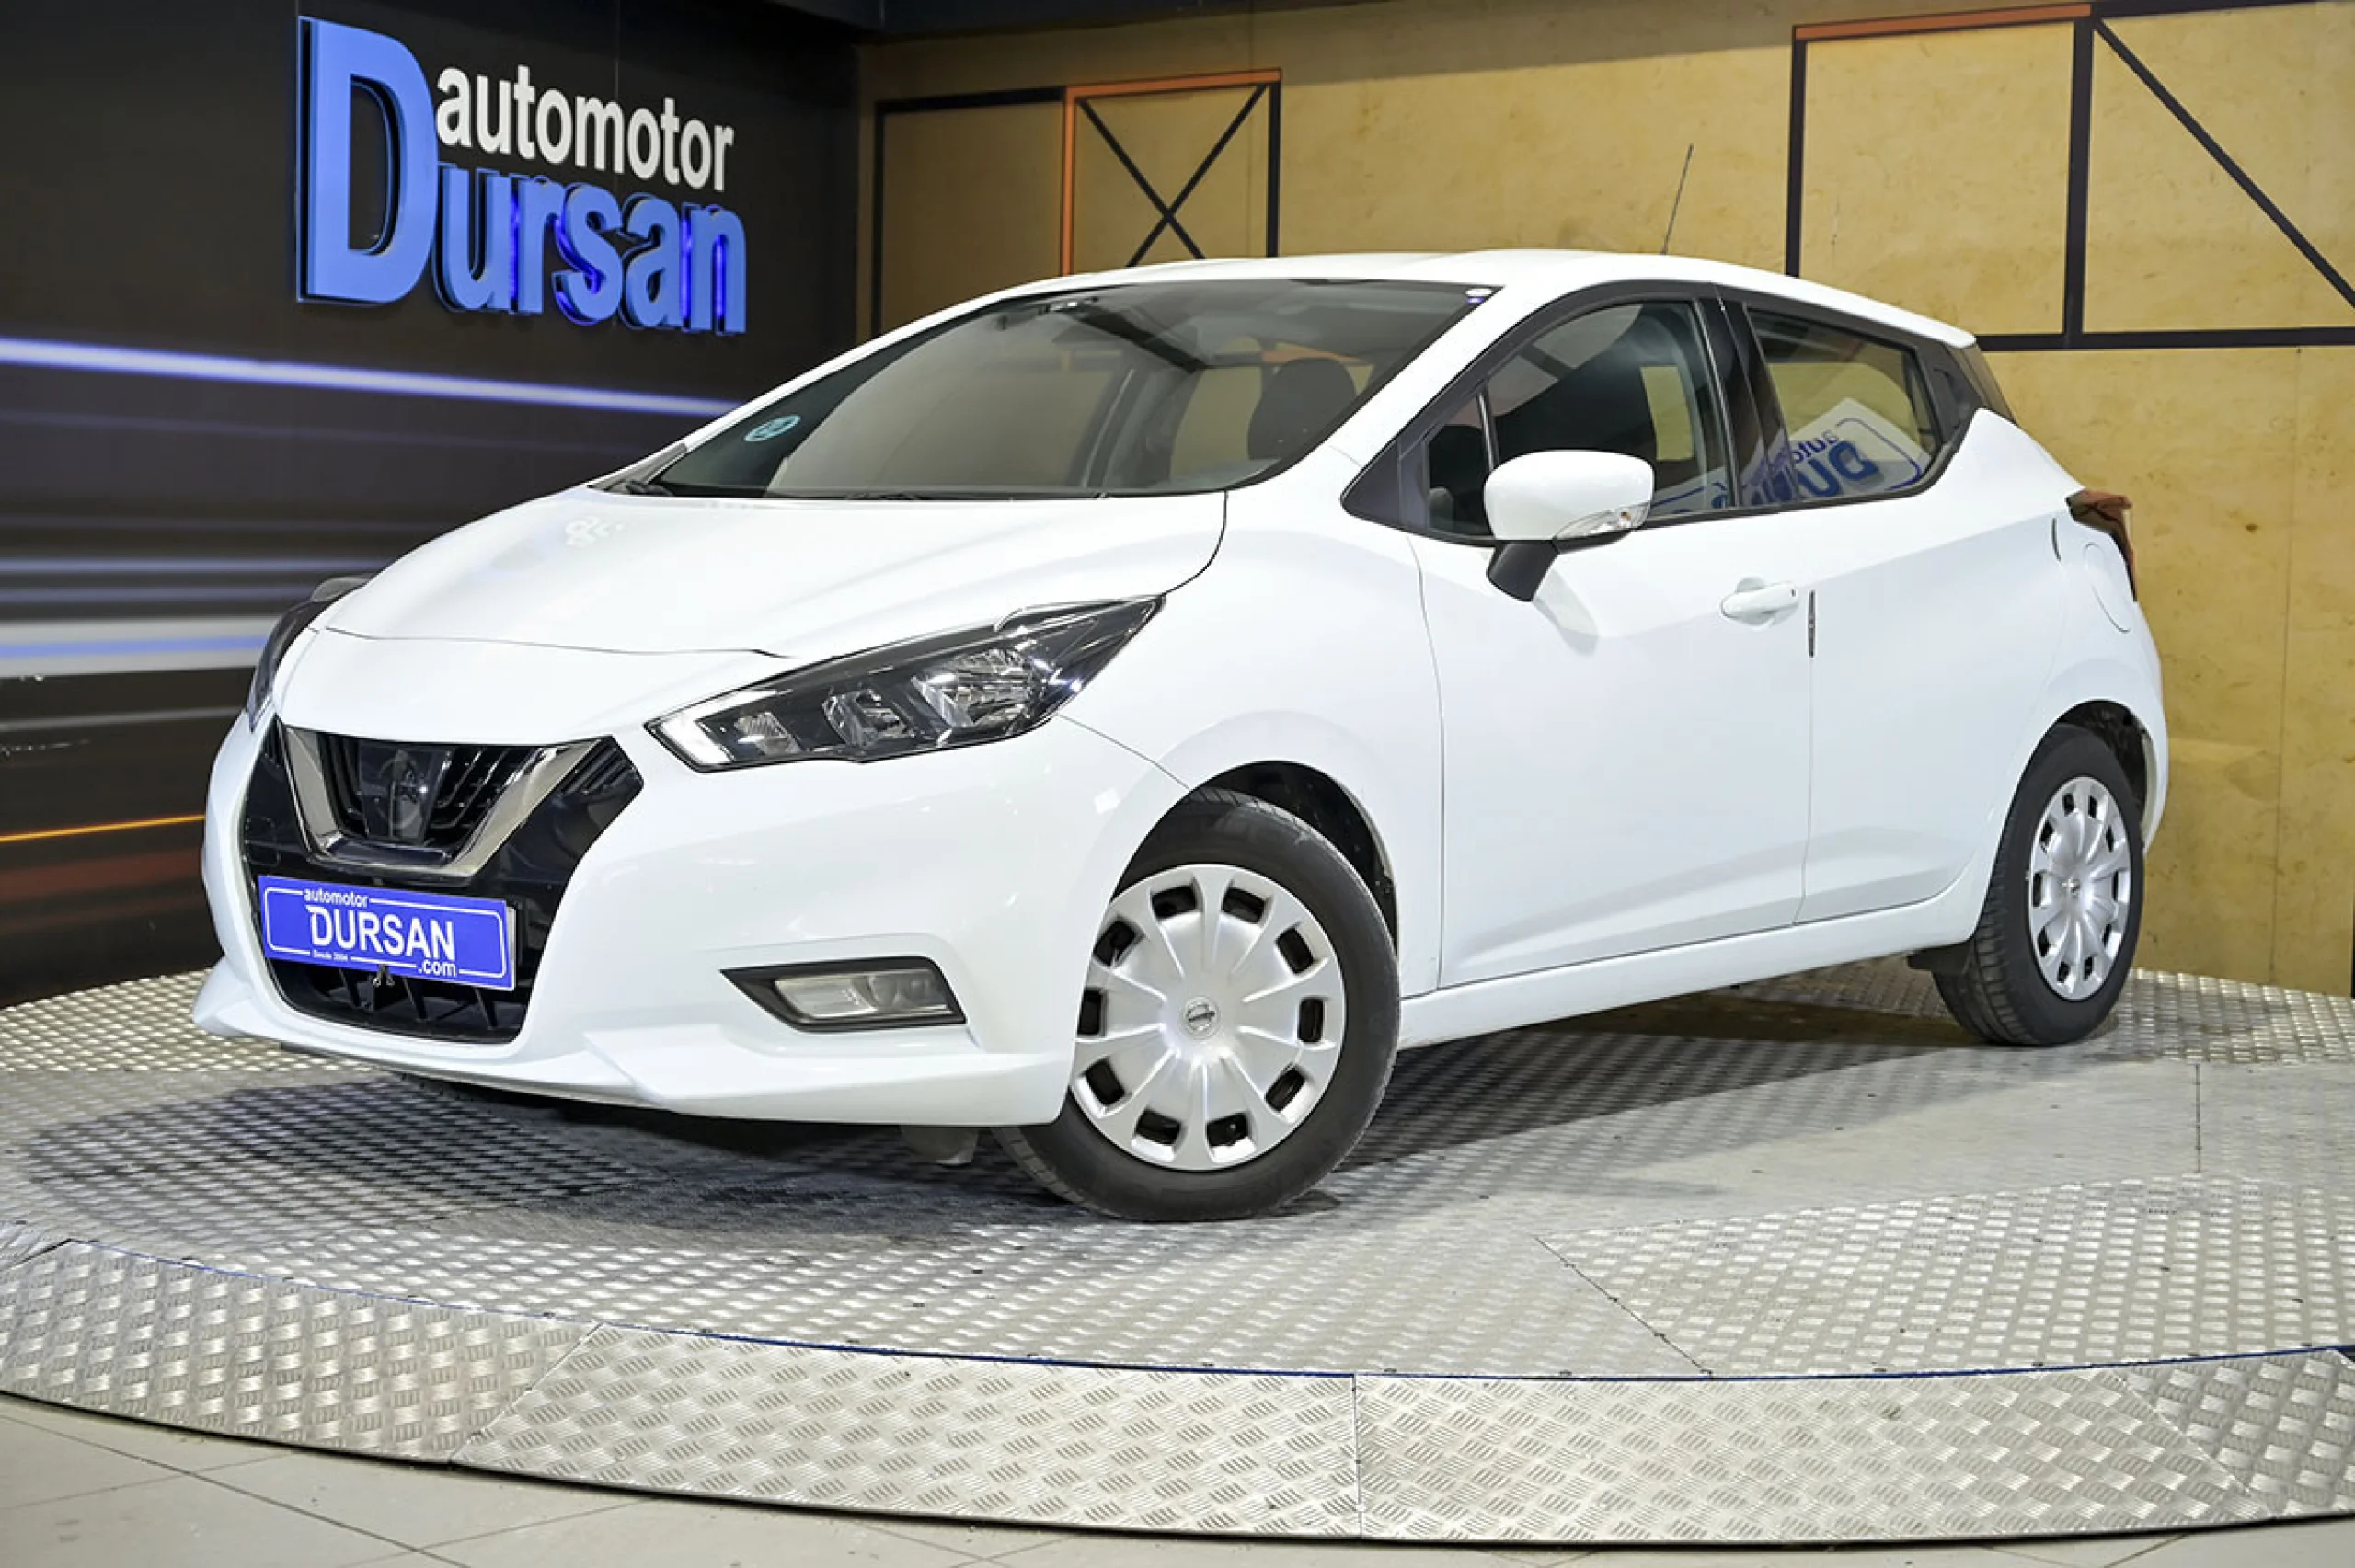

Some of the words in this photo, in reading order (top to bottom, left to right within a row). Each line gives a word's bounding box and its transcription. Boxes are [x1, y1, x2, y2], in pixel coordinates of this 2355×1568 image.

[436, 64, 735, 192] automotor
[303, 887, 369, 908] automotor
[305, 904, 456, 962] DURSAN
[418, 958, 457, 978] .com
